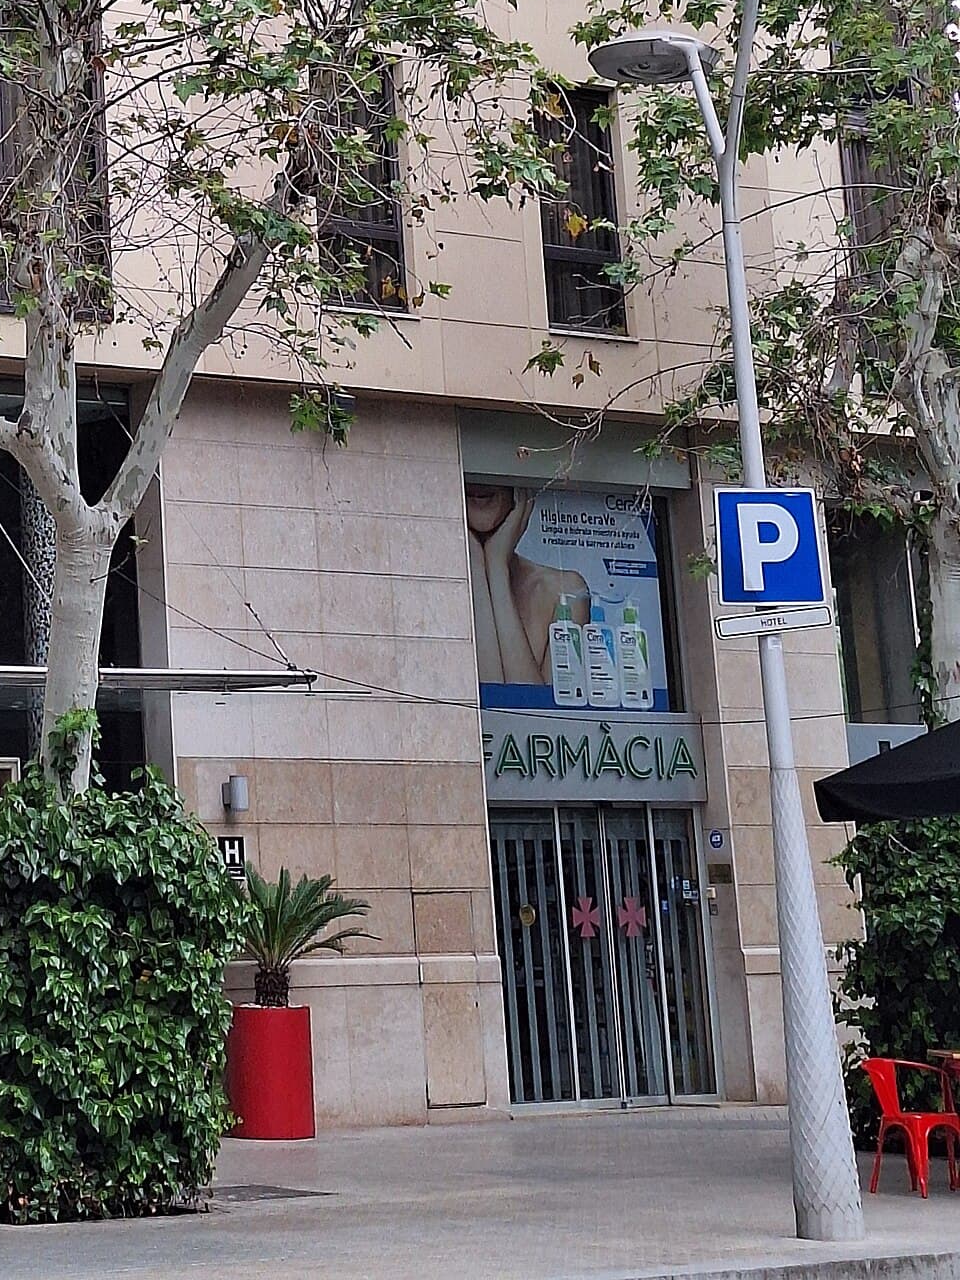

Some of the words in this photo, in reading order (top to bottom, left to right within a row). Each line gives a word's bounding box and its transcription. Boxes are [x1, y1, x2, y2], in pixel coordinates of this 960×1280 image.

[736, 503, 799, 591] P
[760, 617, 788, 627] HOTEL
[224, 839, 240, 865] H
